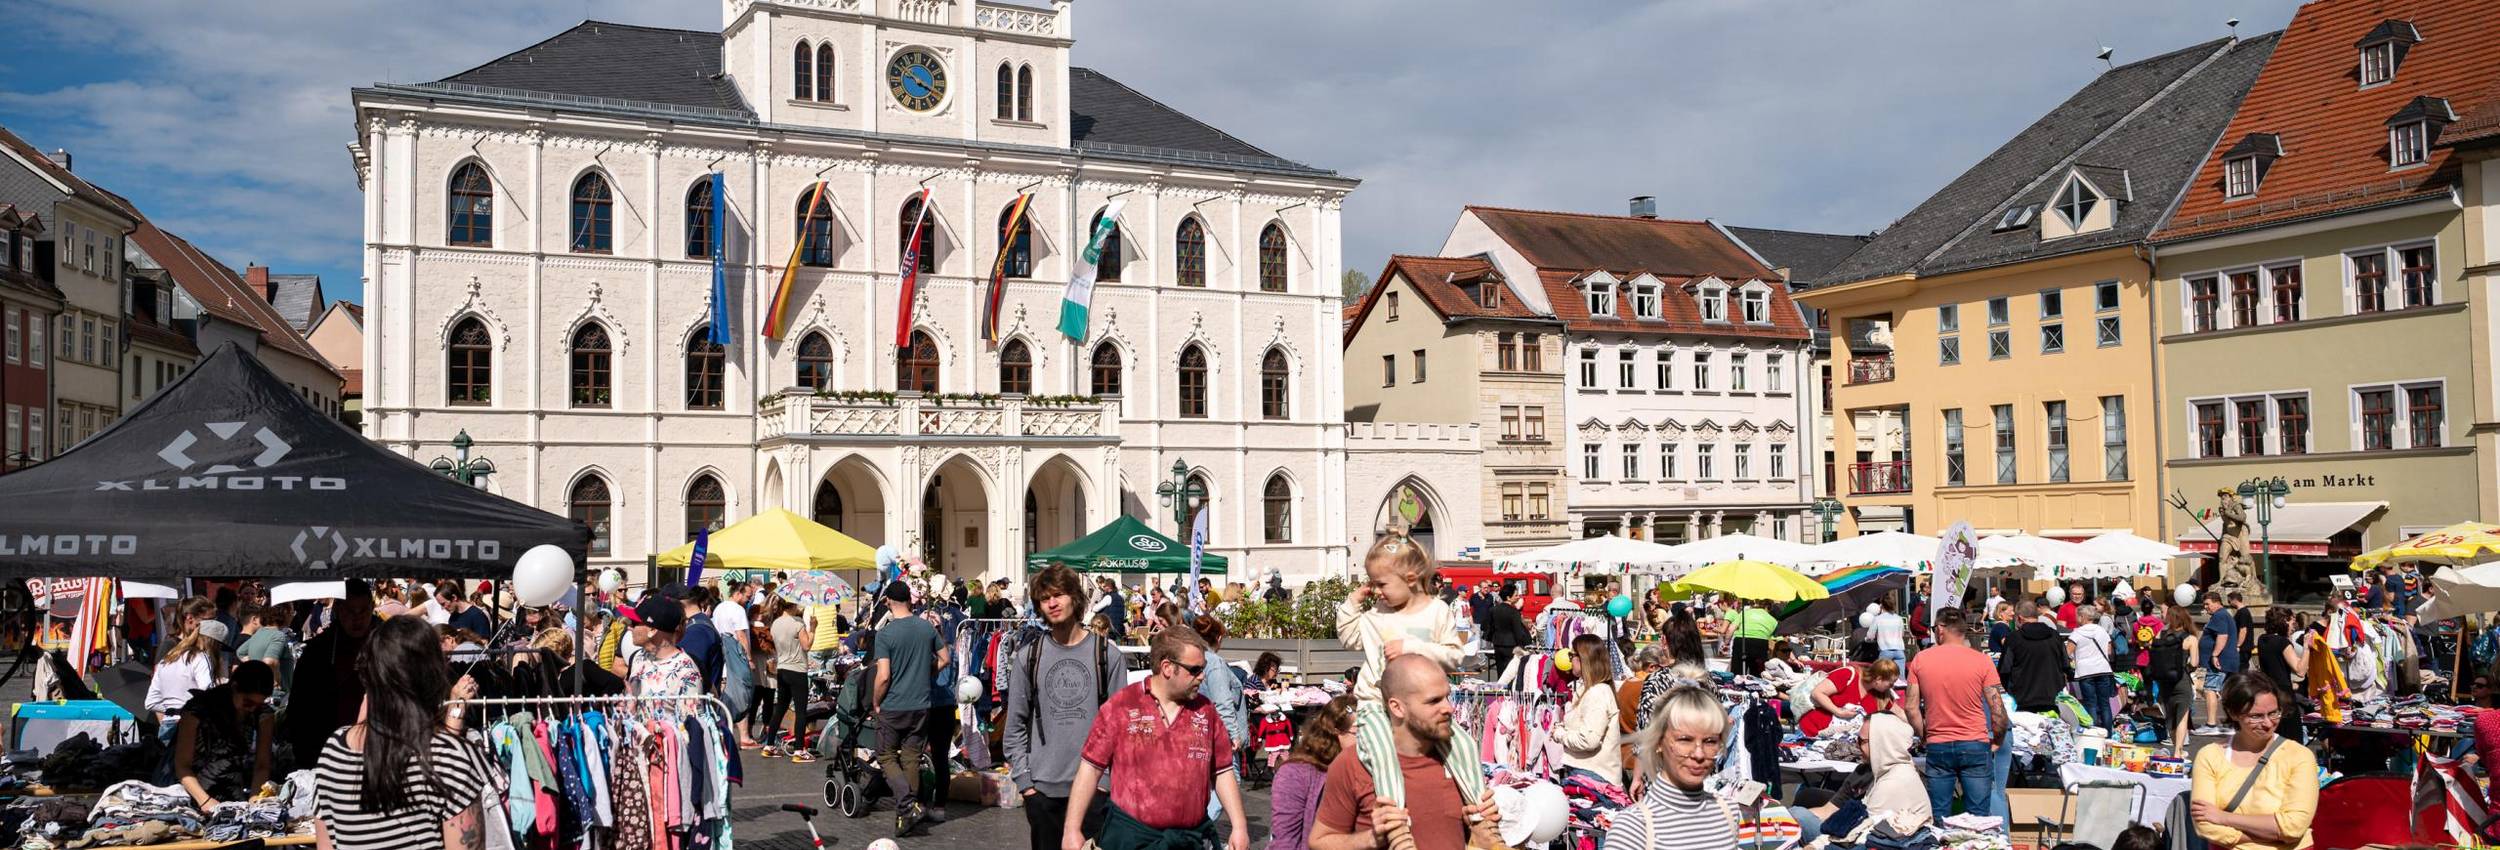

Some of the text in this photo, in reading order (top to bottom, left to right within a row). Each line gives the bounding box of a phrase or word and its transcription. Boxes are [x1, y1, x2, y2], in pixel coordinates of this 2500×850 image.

[95, 476, 347, 491] XLMOTO
[2293, 478, 2316, 488] am
[2322, 473, 2376, 487] Markt
[352, 537, 500, 561] XLMOTO
